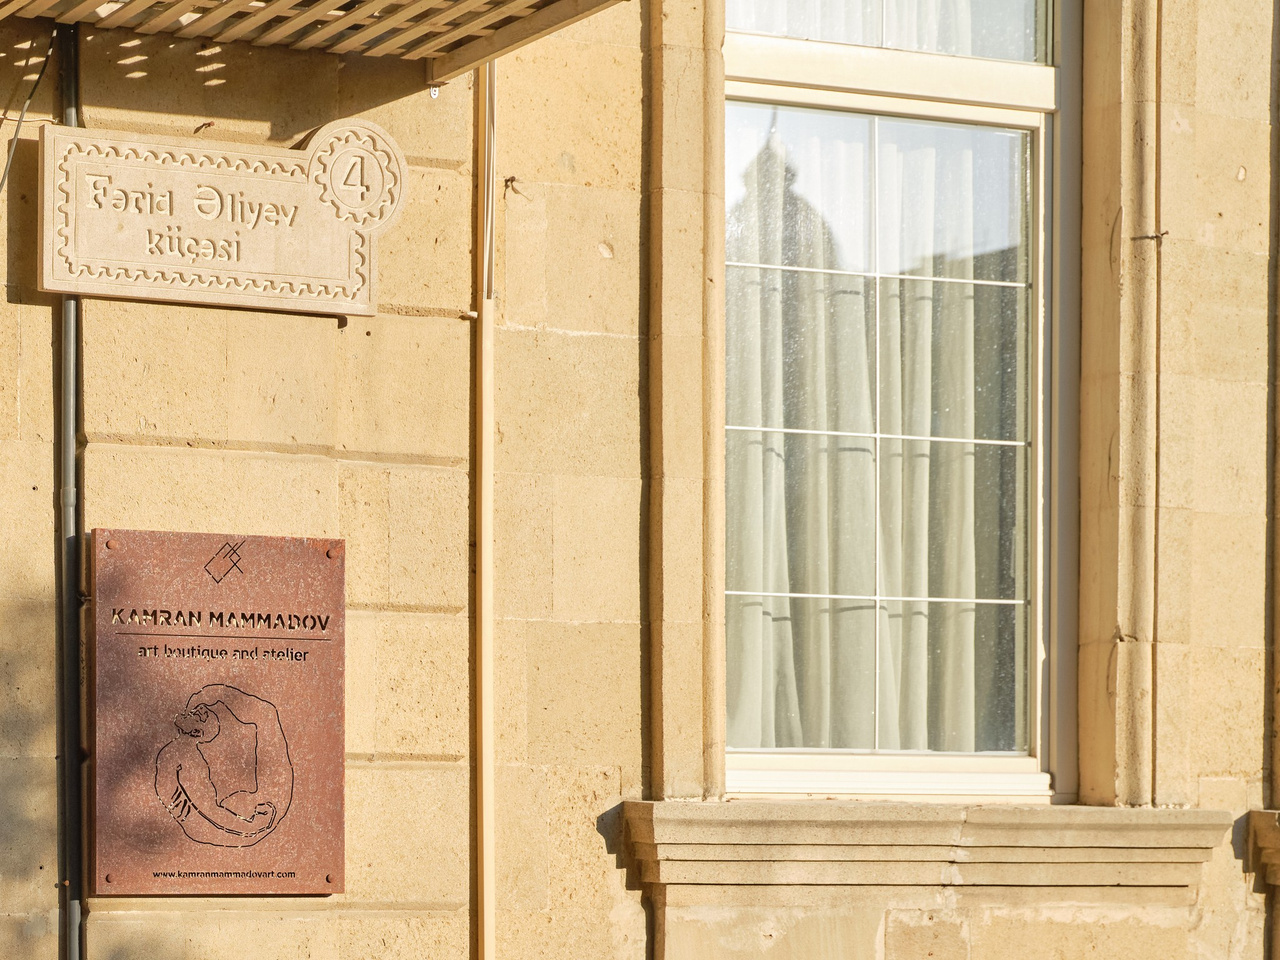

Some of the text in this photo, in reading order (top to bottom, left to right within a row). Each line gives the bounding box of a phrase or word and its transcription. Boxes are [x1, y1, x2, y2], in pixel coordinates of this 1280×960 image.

[340, 154, 370, 202] 4
[85, 173, 298, 230] Fərid Əliyev
[146, 225, 241, 263] küçəsi
[111, 608, 331, 633] KAMRAN MAMMADOV
[138, 644, 309, 662] art boutique and atelier
[152, 869, 296, 879] www.kamranmammadovart.com
